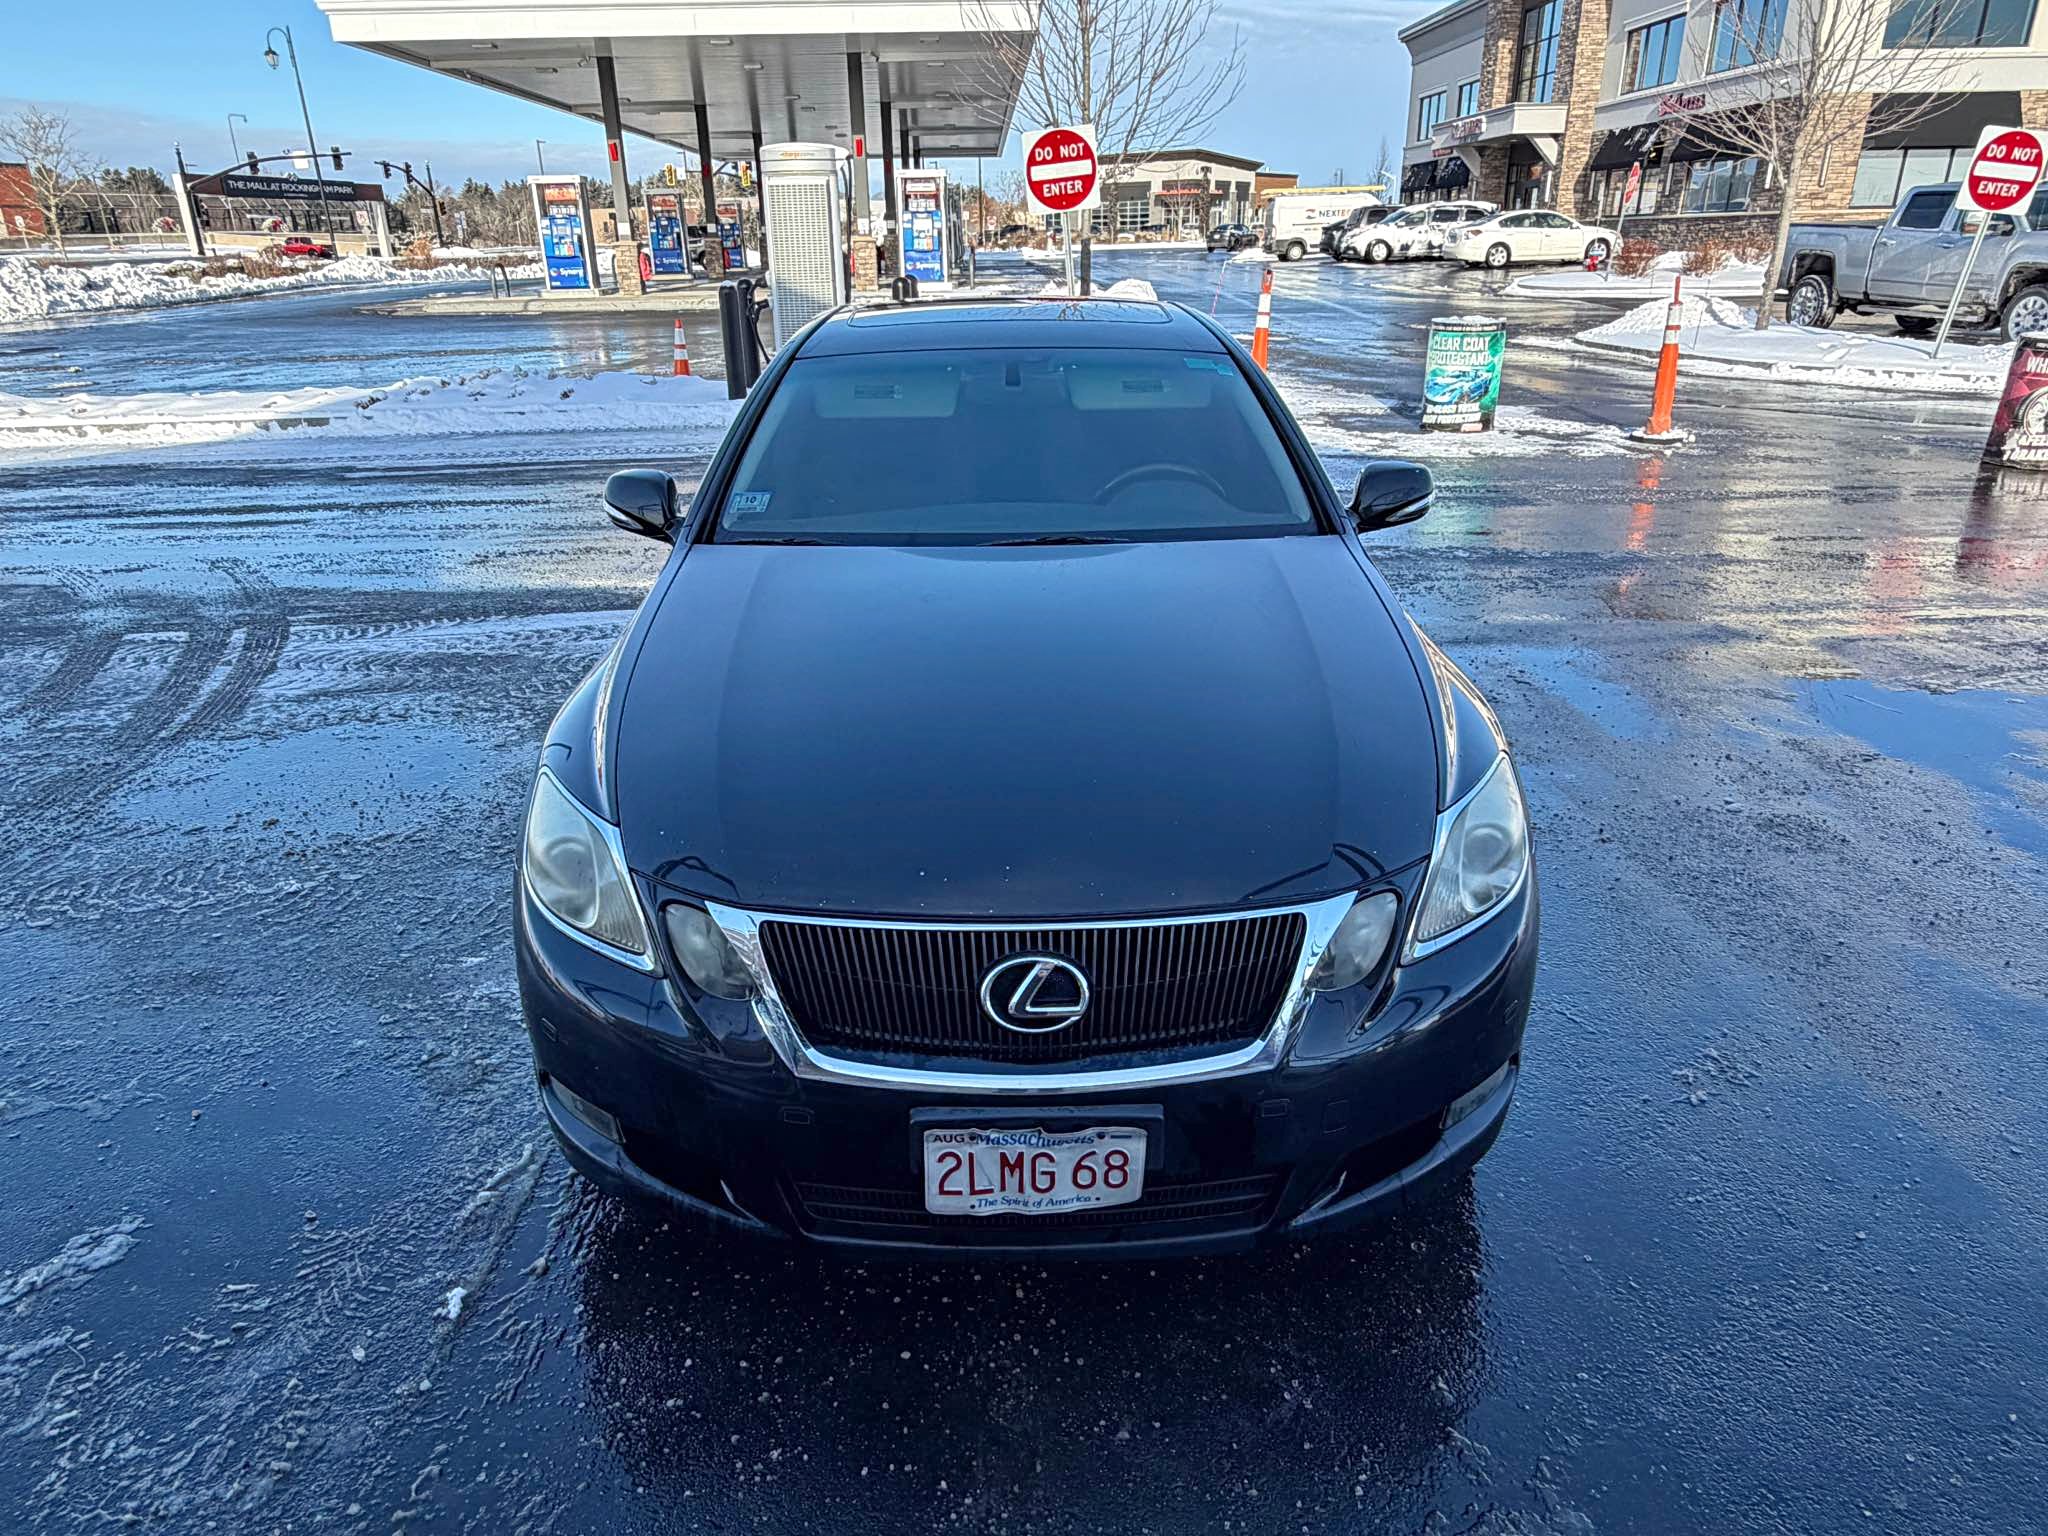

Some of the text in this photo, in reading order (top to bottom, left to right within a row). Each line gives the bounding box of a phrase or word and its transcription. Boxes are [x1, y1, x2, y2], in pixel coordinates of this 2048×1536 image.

[1035, 143, 1085, 162] DO NOT
[1986, 144, 2040, 162] DO NOT
[227, 180, 246, 189] THE
[246, 181, 270, 190] MALL
[270, 183, 280, 191] AT
[333, 186, 354, 195] PARK
[1043, 180, 1083, 197] ENTER
[1977, 181, 2020, 197] ENTER
[1433, 336, 1489, 351] CLEAR COAT
[933, 1133, 965, 1143] AUG
[976, 1131, 1095, 1148] Massachusetts
[936, 1150, 1130, 1196] 2LMG 68
[977, 1194, 1091, 1209] The Spirit of America
